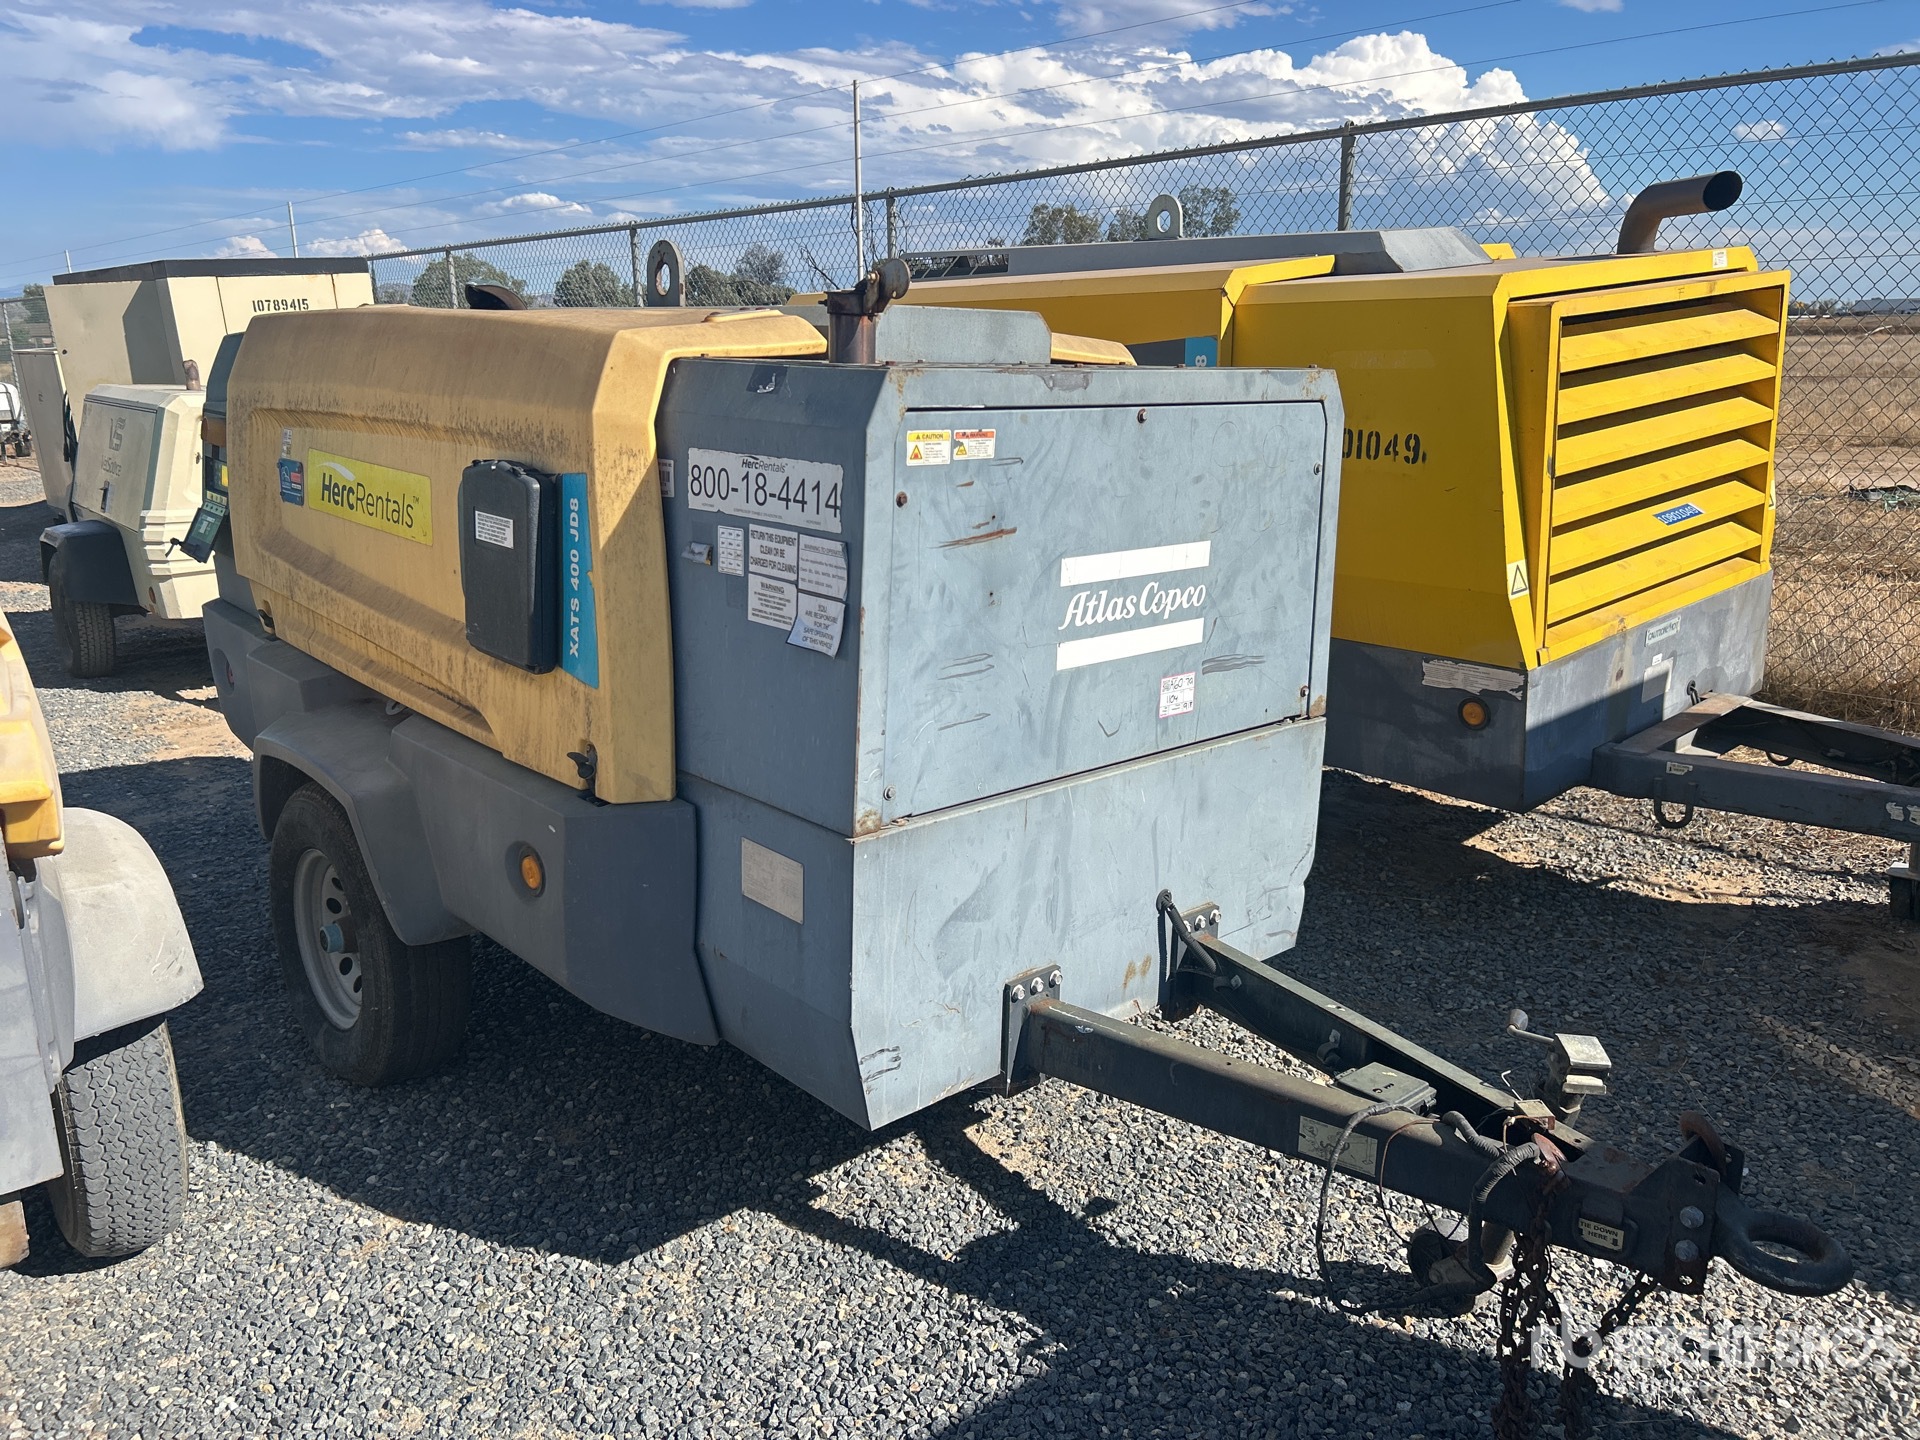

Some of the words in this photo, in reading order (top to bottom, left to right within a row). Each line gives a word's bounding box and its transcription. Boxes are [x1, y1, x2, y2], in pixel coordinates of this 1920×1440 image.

[252, 298, 309, 312] 10789415
[690, 463, 841, 518] 800-18-4414
[569, 497, 579, 543] JD8
[750, 529, 766, 541] RETURN
[765, 532, 775, 543] THIS
[760, 544, 773, 556] CLEAN
[779, 548, 786, 559] BE
[569, 548, 580, 592] 400
[1058, 589, 1138, 631] Atlas
[1139, 581, 1207, 620] Copco
[569, 597, 580, 659] XATS
[1580, 1221, 1591, 1230] TIE
[1593, 1225, 1619, 1238] DOWN
[1587, 1230, 1608, 1242] HERE
